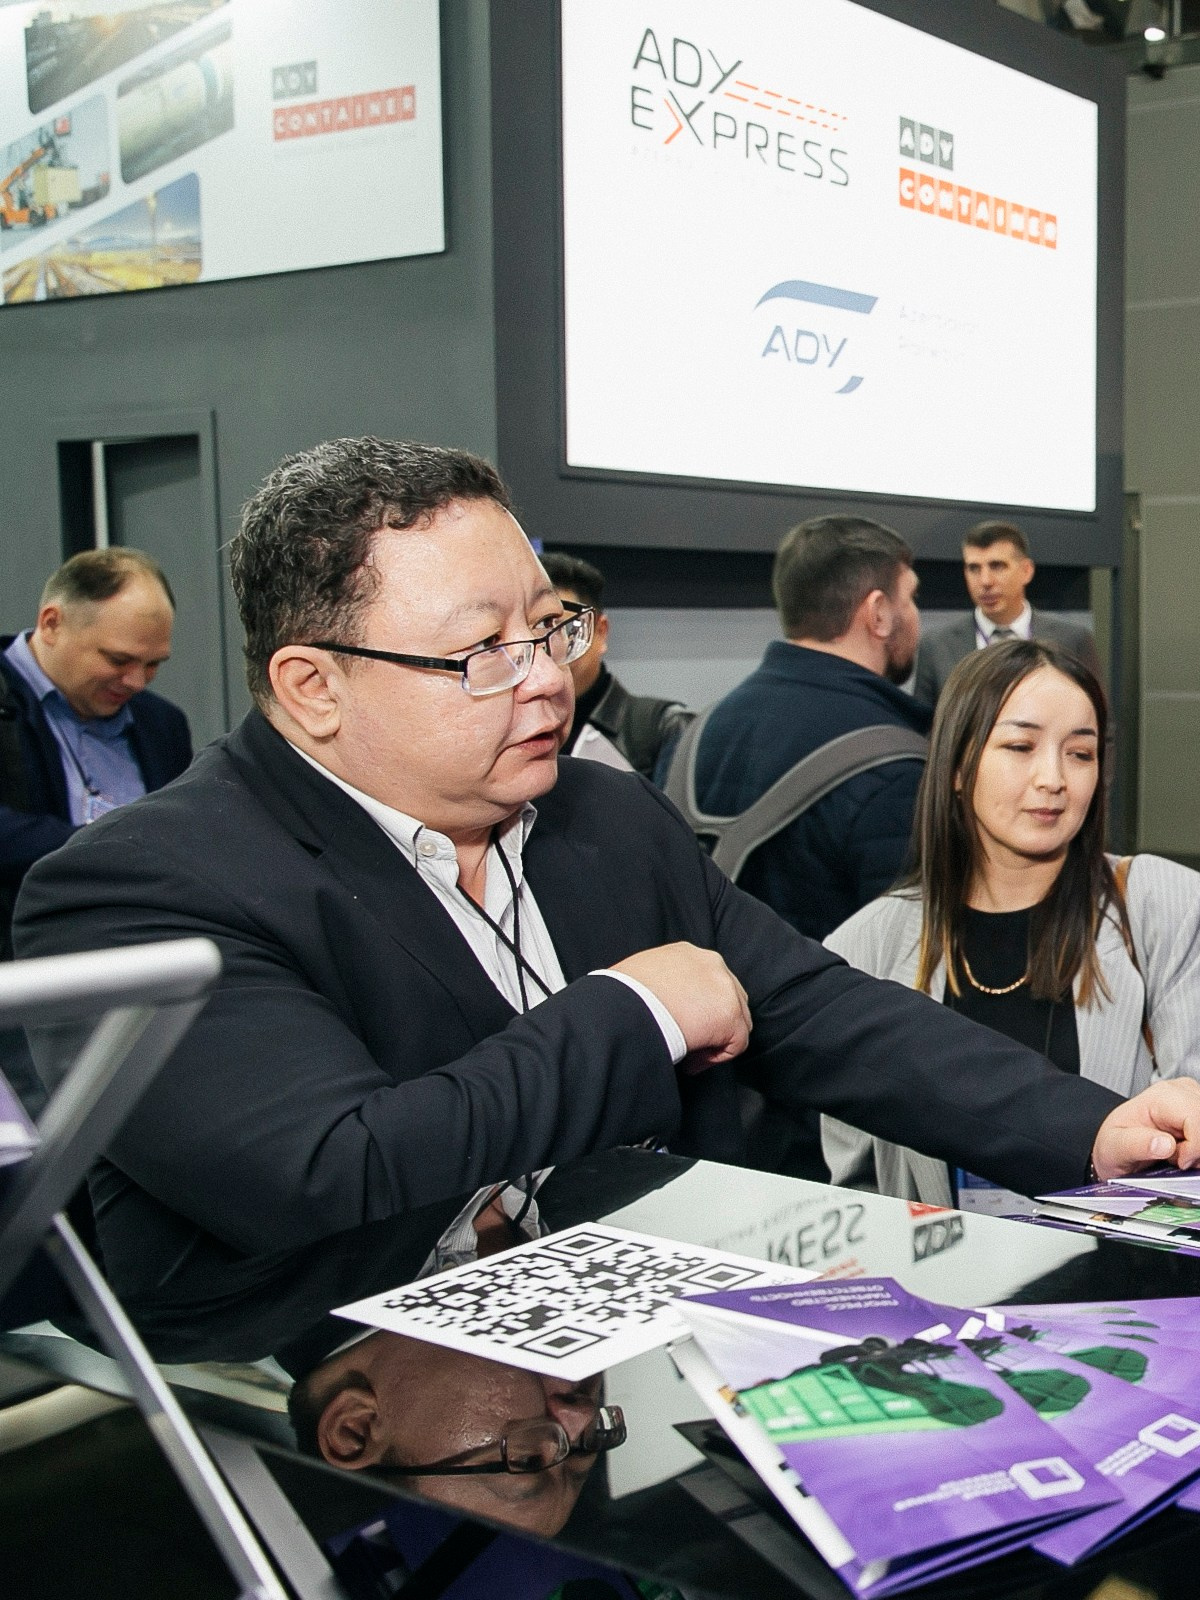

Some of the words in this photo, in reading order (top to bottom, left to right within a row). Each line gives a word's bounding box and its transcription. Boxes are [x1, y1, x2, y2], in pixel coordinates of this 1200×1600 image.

[632, 28, 744, 95] ADY
[274, 88, 415, 138] CONTAINER
[631, 86, 849, 187] EXPRESS
[900, 122, 953, 167] ADY
[900, 171, 1057, 246] CONTAINER
[762, 324, 848, 368] ADY
